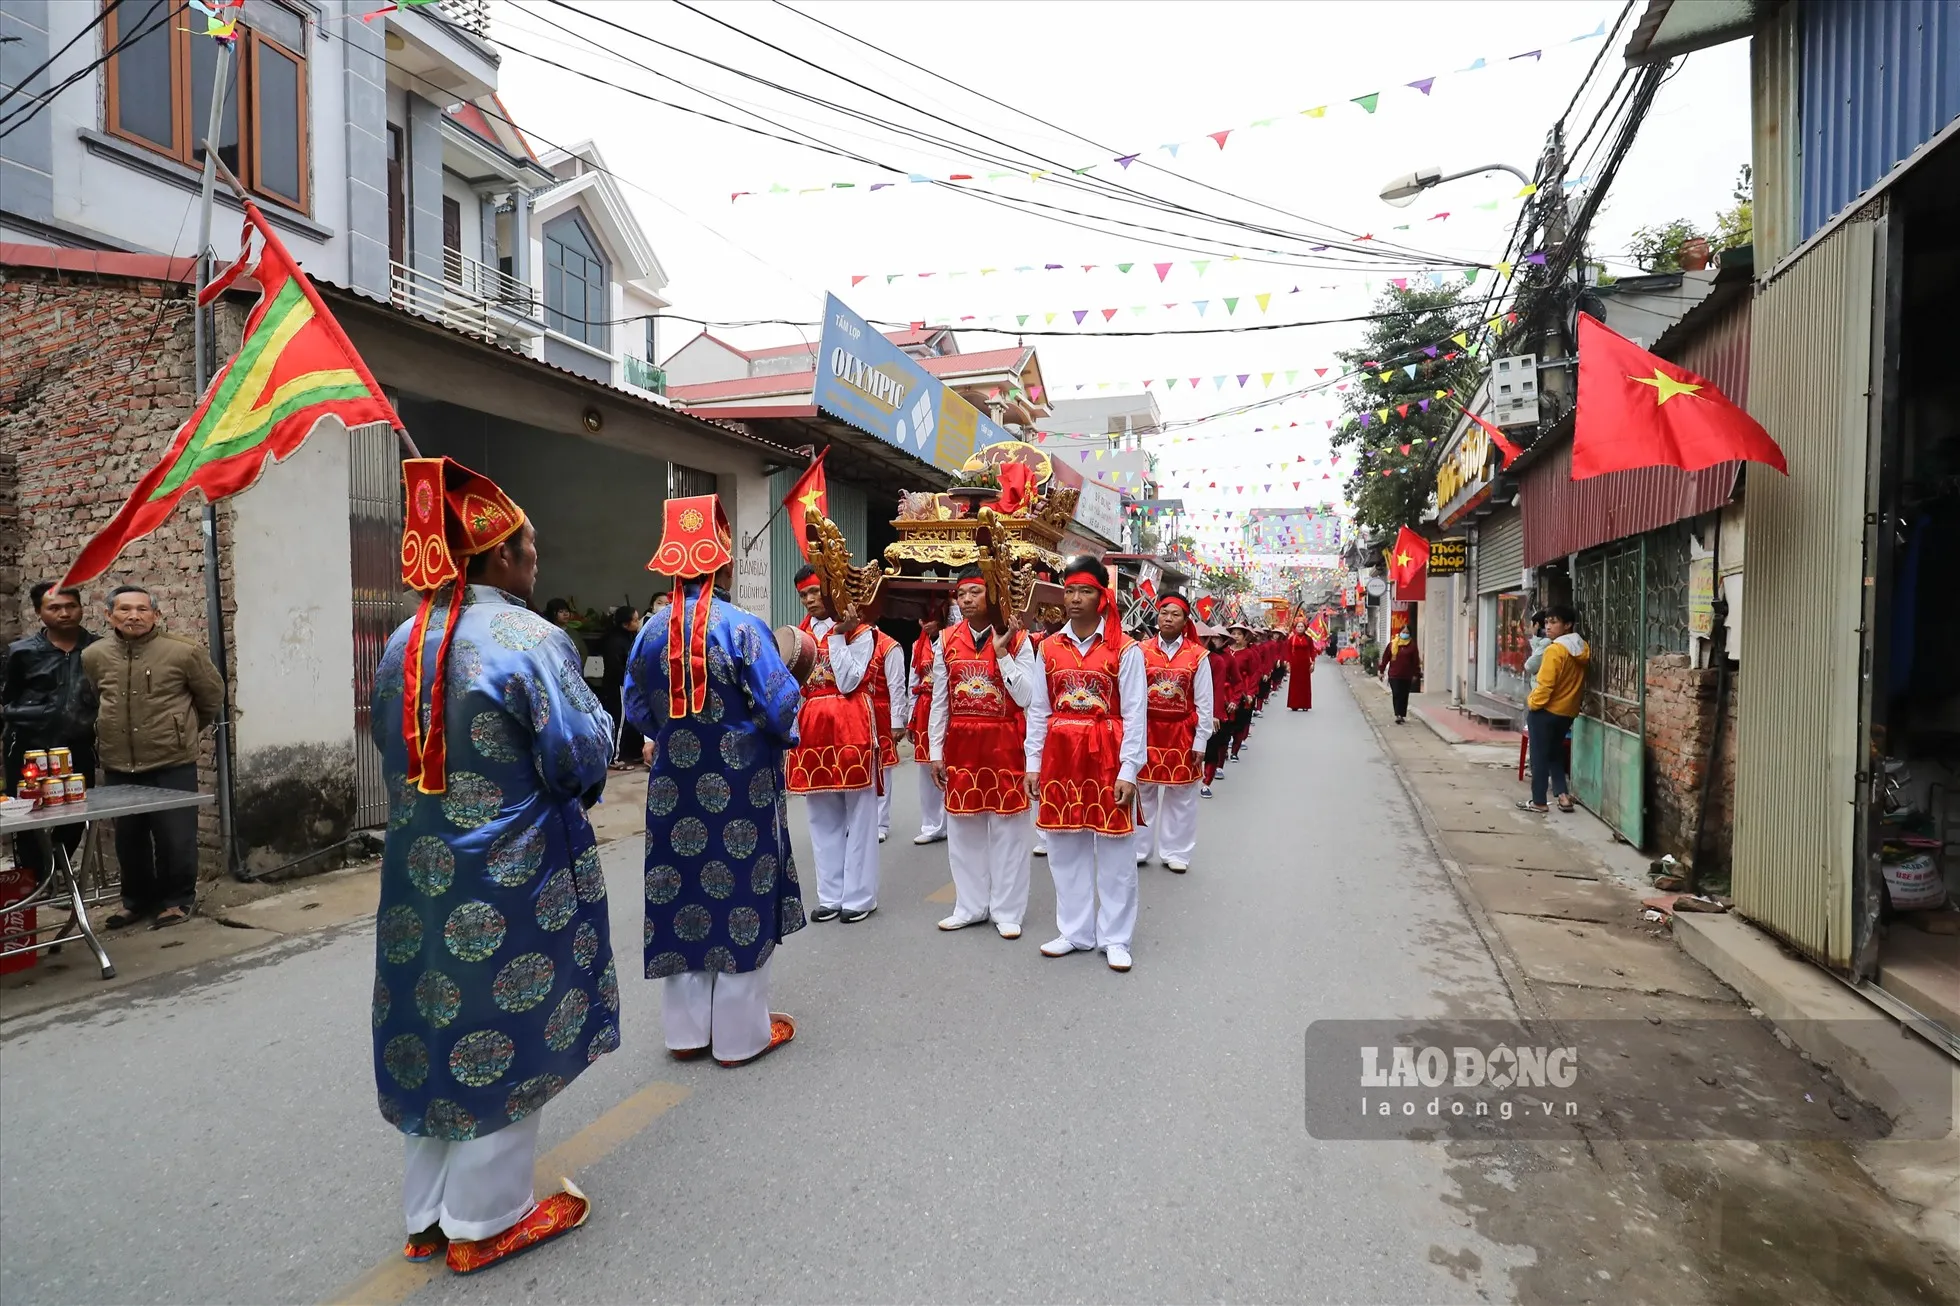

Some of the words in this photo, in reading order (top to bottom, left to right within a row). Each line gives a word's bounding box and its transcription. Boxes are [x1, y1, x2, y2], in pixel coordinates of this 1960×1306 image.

[835, 314, 849, 332] TẤM
[849, 324, 861, 340] LỢP
[831, 346, 906, 410] OLYMPIC
[1430, 554, 1465, 567] Shop
